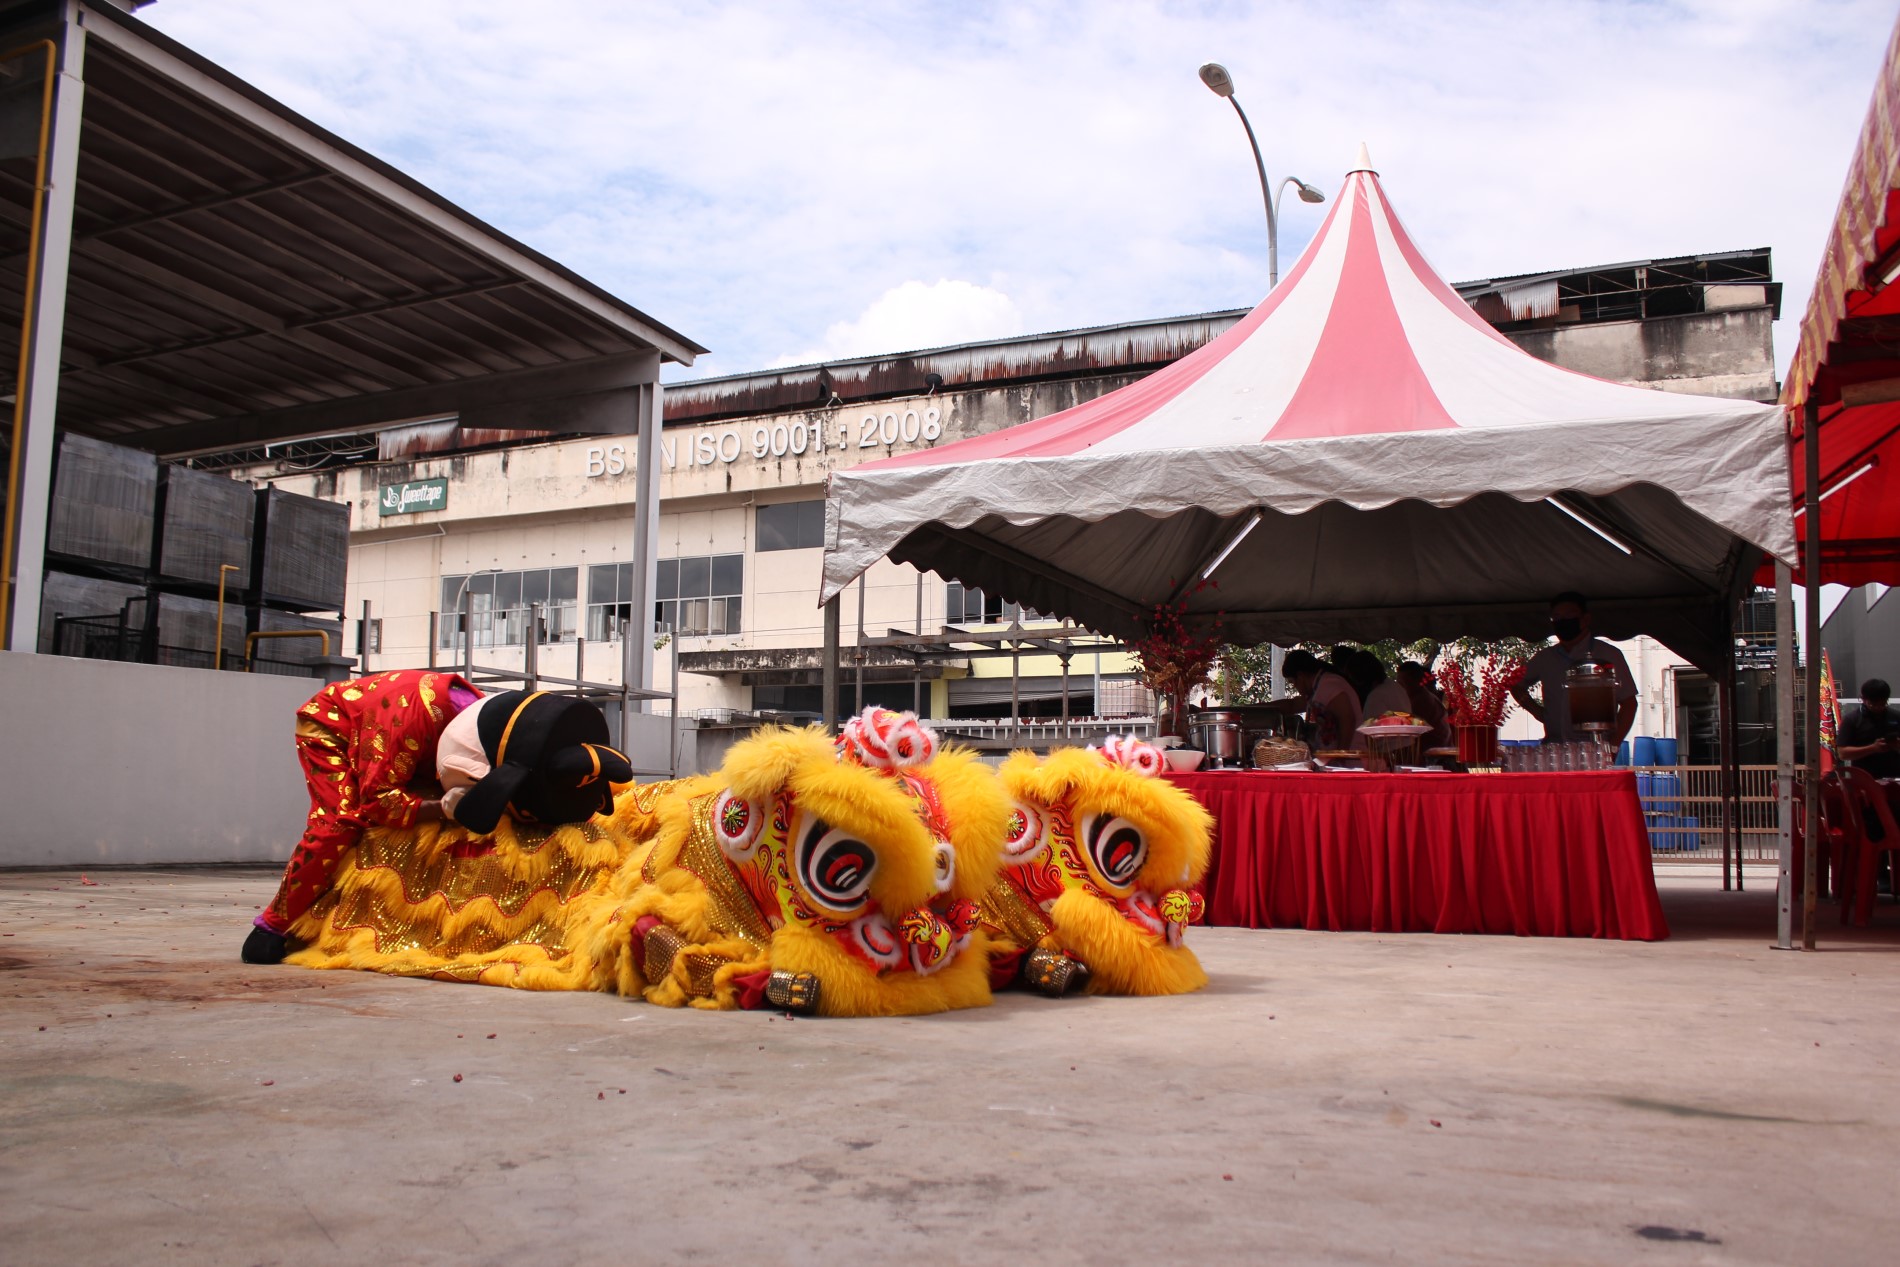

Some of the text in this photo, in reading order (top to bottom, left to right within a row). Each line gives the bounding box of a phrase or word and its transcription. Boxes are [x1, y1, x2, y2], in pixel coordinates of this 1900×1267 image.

[586, 443, 626, 478] BS
[688, 429, 741, 467] ISO
[752, 419, 822, 459] 9001
[859, 406, 941, 448] 2008
[398, 484, 443, 513] Sweettape
